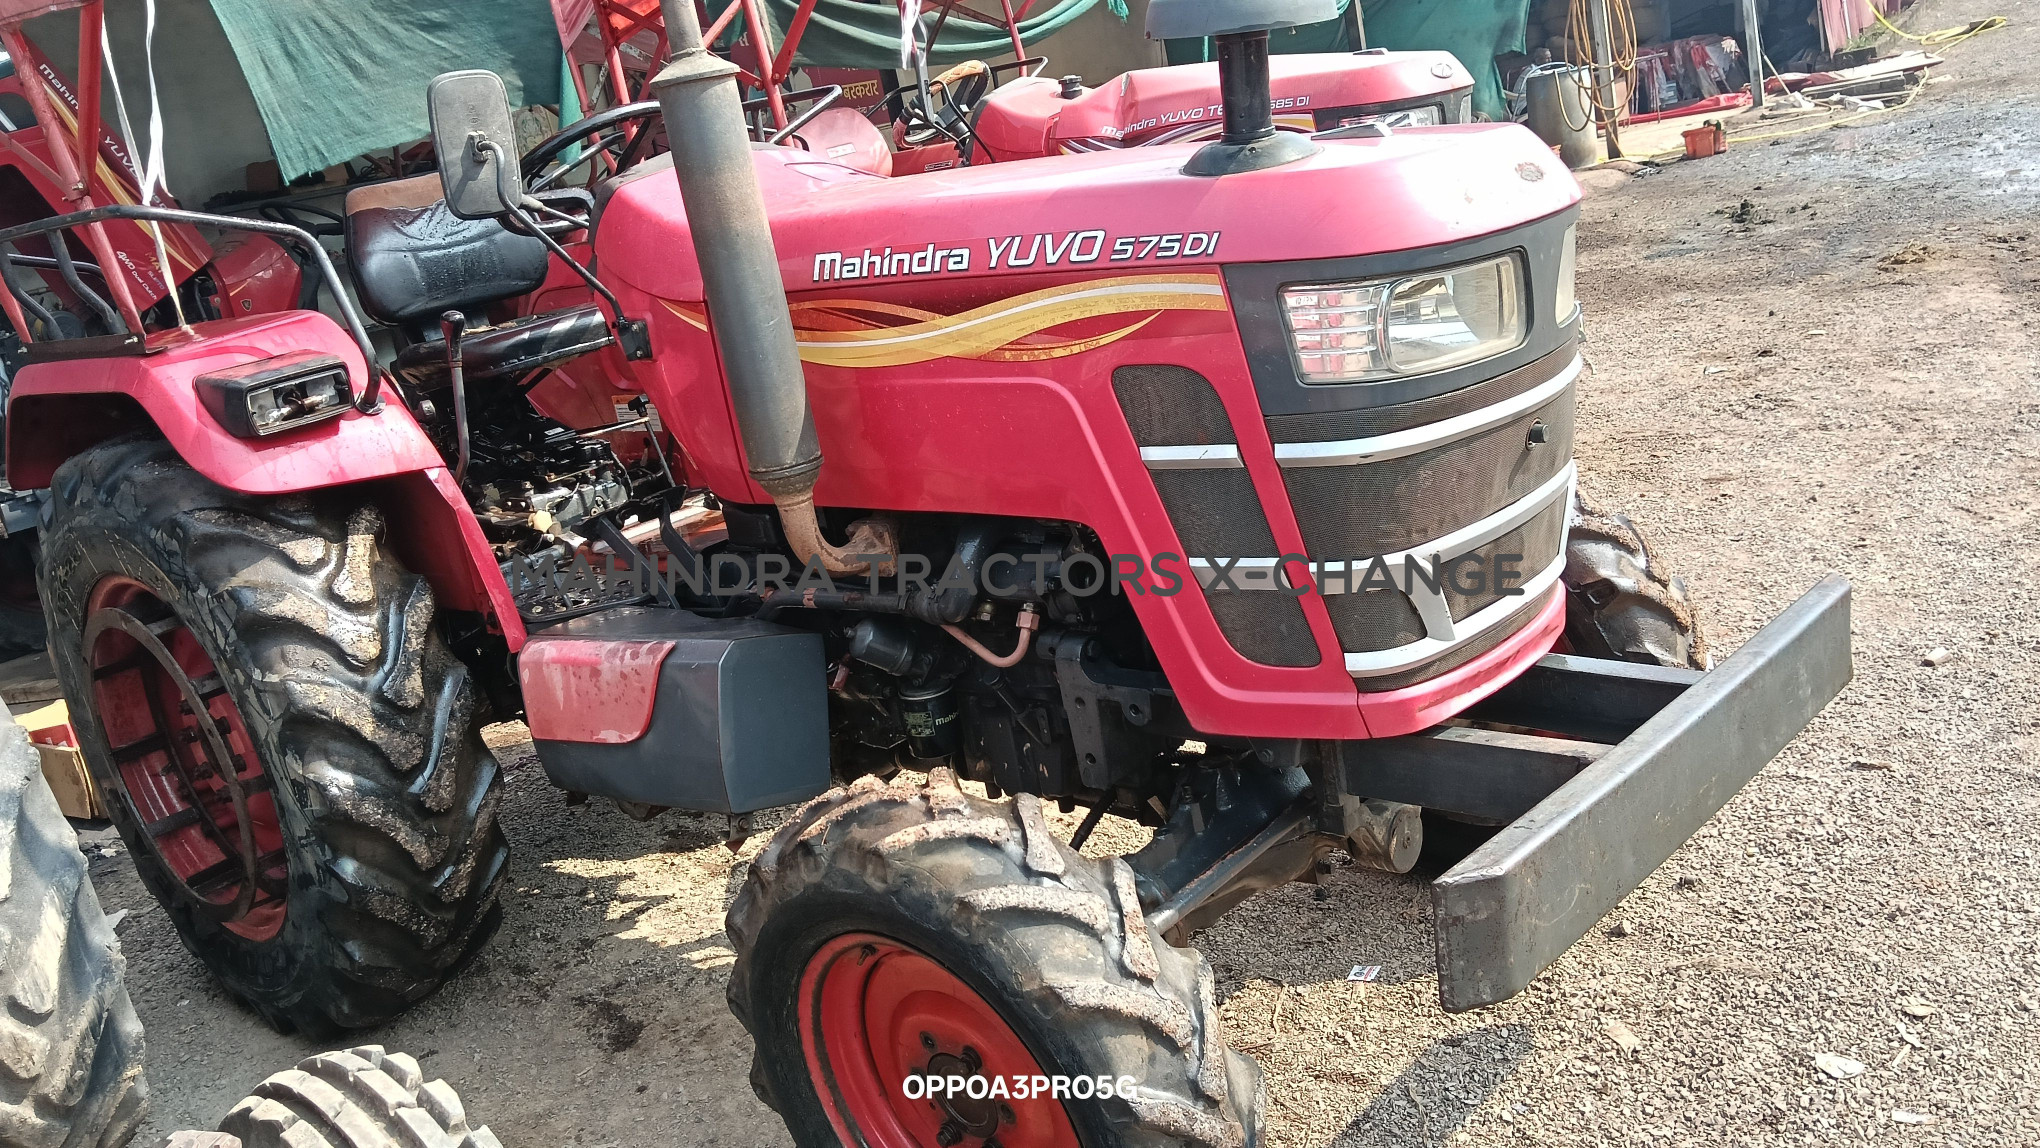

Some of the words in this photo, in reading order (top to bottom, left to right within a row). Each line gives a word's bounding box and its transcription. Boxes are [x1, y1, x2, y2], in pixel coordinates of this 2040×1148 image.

[1101, 118, 1157, 140] Maindra
[1160, 107, 1204, 124] YUVO
[1296, 96, 1310, 106] DI
[116, 250, 136, 270] 4WD
[813, 244, 971, 282] Mahindra
[987, 229, 1107, 269] YUVO
